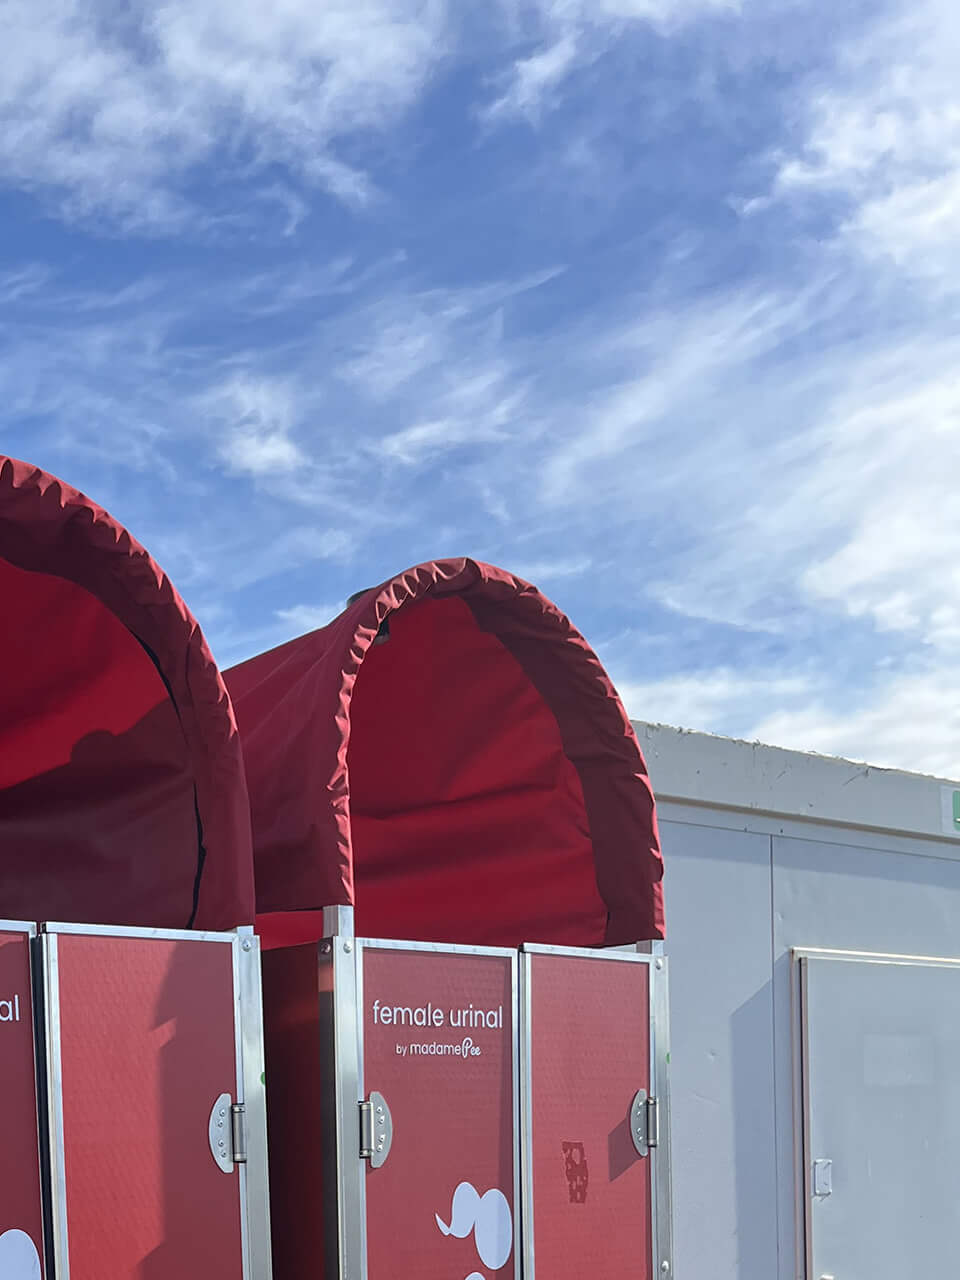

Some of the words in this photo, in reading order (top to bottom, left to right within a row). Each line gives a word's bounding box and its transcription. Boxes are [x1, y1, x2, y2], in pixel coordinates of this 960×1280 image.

[372, 999, 445, 1027] female
[449, 1003, 503, 1029] urinal
[395, 1043, 408, 1057] by
